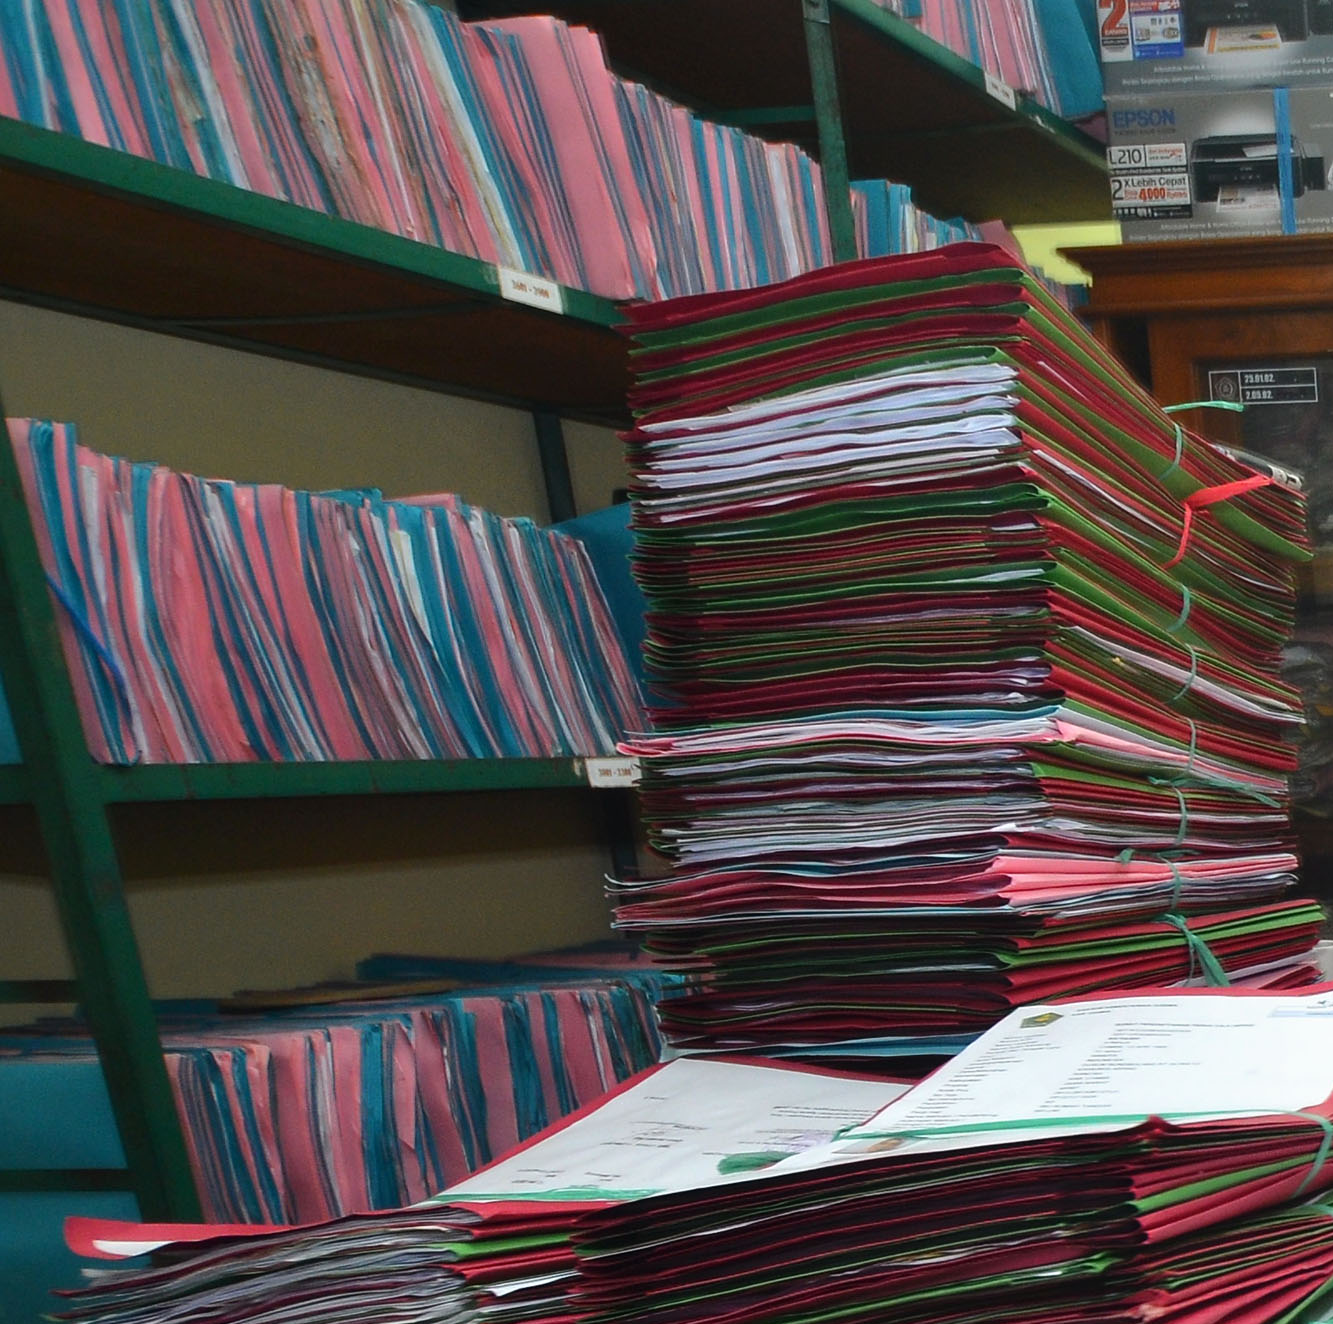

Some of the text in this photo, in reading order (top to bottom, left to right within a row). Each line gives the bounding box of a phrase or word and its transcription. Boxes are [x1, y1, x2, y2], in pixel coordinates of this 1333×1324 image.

[1112, 108, 1176, 128] EPSON
[1108, 148, 1142, 166] L210
[1158, 176, 1186, 187] Cepat
[1139, 187, 1166, 201] 4000
